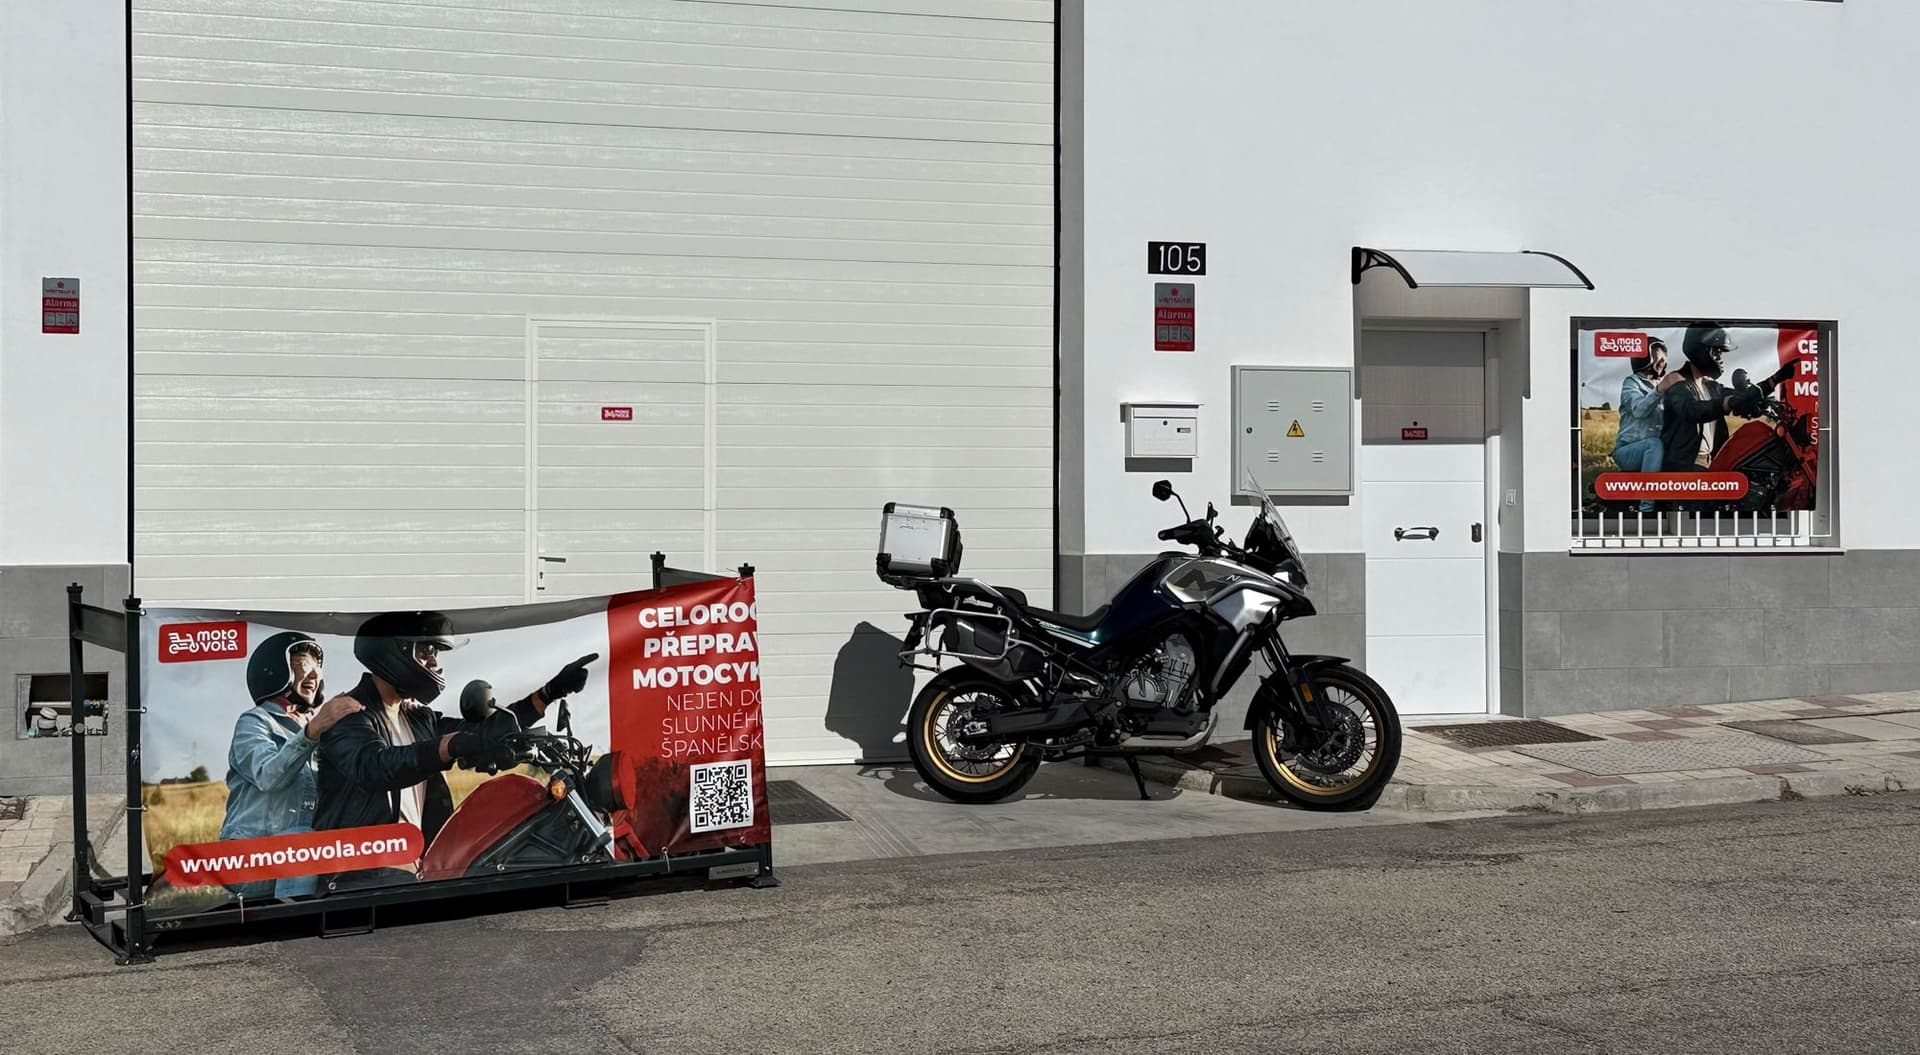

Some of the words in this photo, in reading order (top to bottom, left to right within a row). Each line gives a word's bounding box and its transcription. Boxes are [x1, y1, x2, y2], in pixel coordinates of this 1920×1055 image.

[1159, 245, 1201, 271] 105
[1605, 479, 1739, 491] www.motovola.com
[643, 630, 759, 659] PŘEPRA
[667, 690, 733, 712] NEJEN
[662, 708, 763, 735] SLUNNÉH
[180, 837, 408, 874] www.motovola.com
